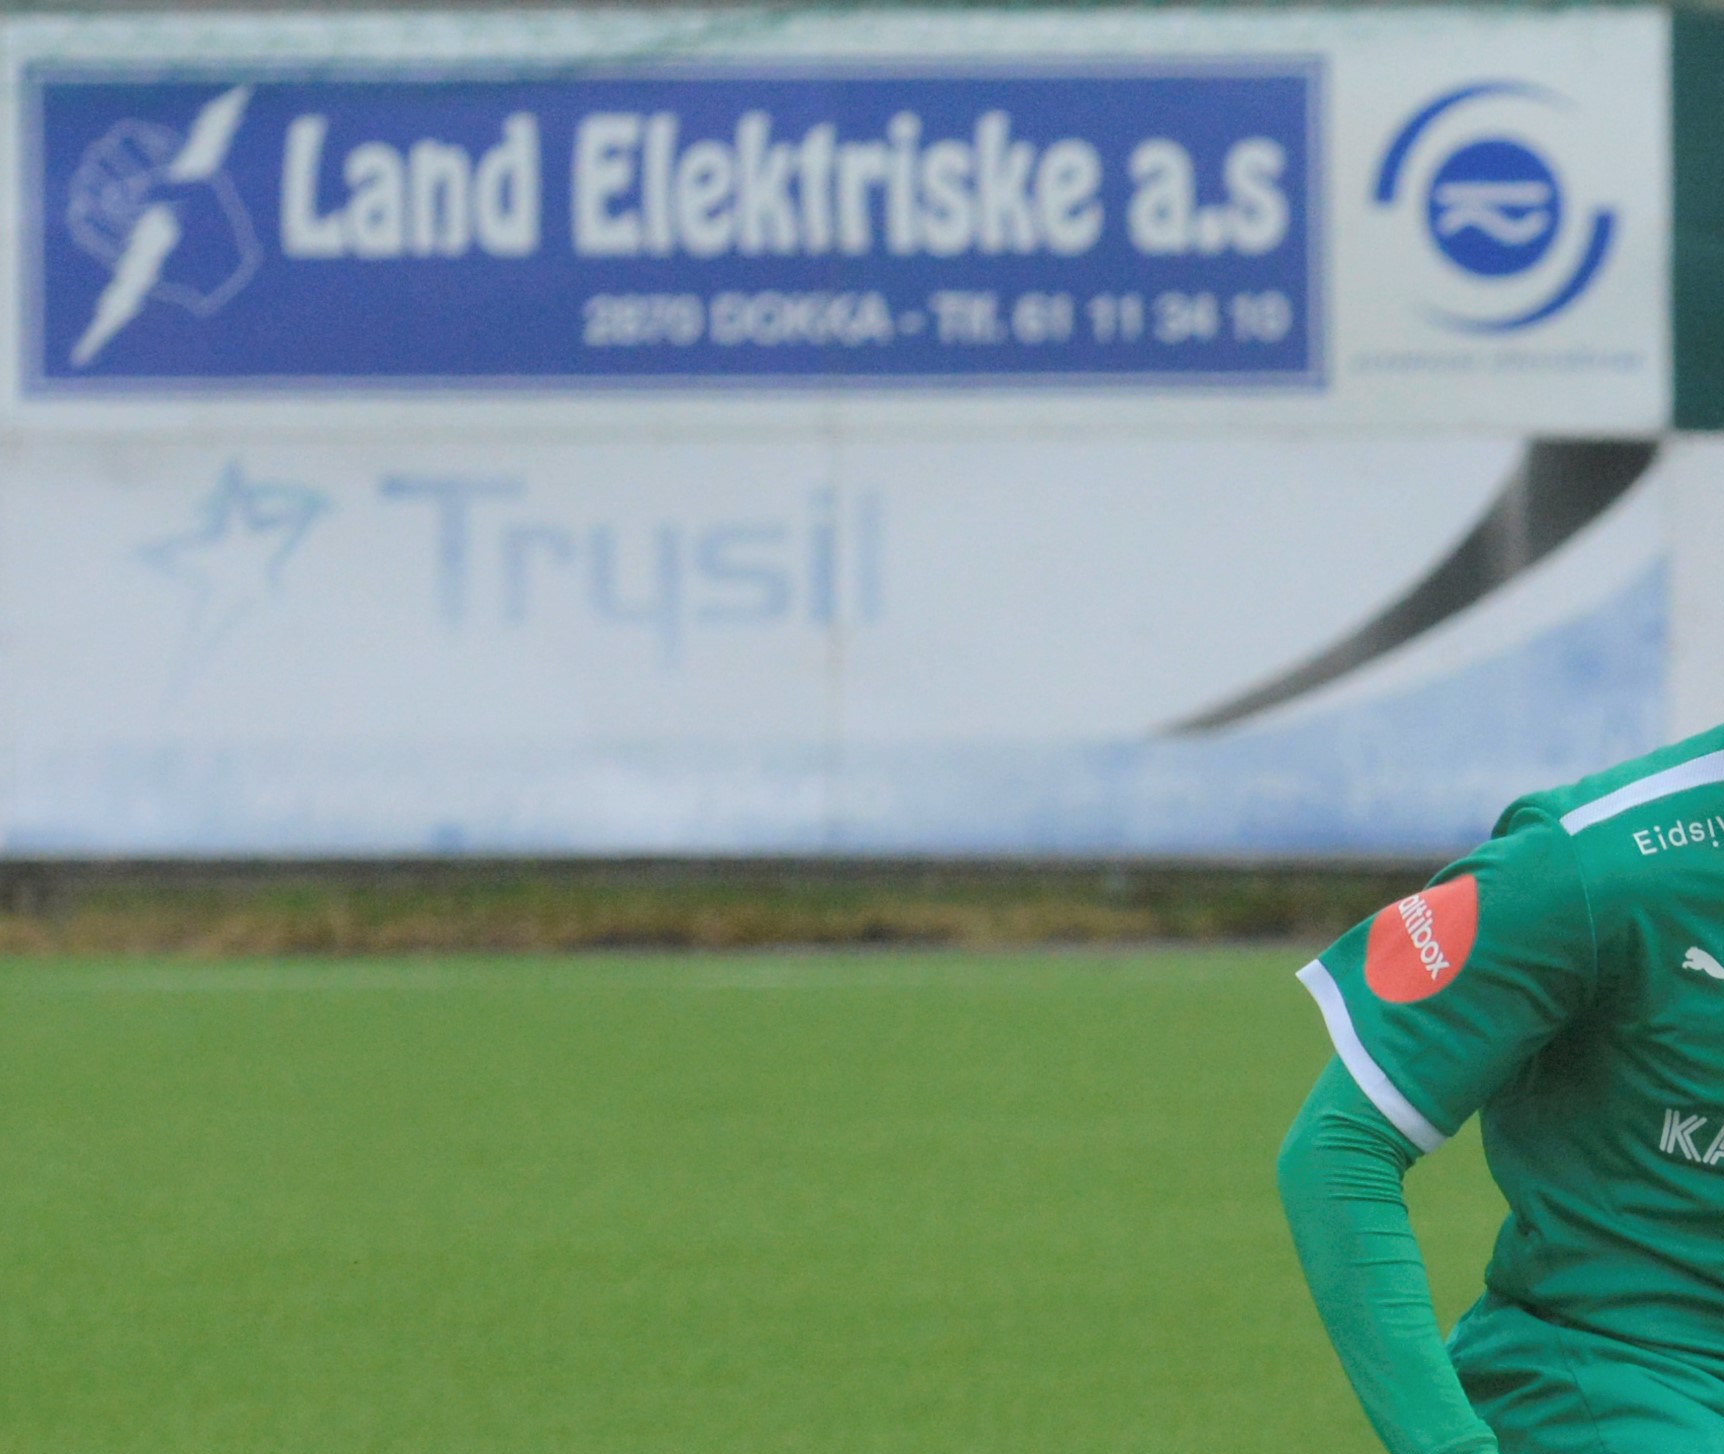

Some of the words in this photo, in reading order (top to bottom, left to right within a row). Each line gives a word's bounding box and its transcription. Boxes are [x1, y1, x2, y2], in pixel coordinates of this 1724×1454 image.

[280, 110, 543, 258] Land
[570, 110, 1104, 258] Elektriske
[1127, 138, 1291, 257] a.s
[375, 472, 890, 672] Trysil
